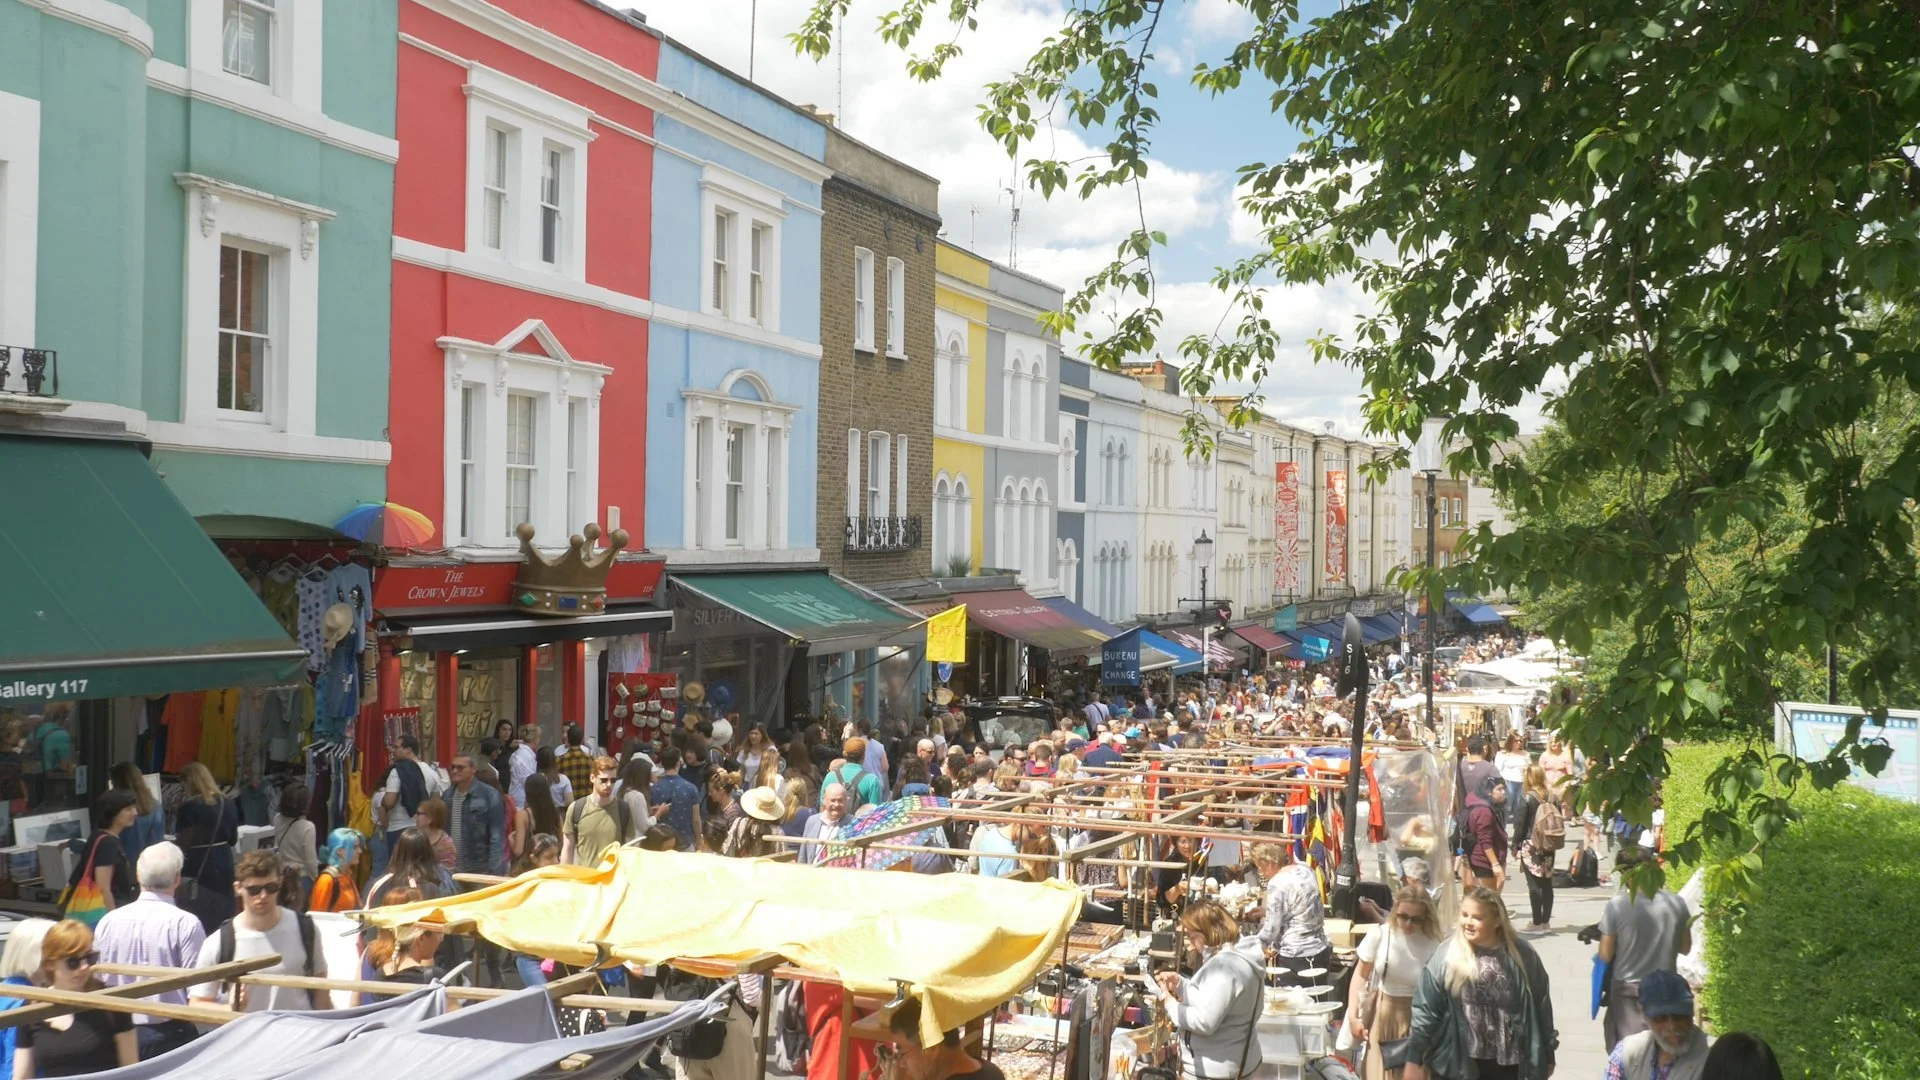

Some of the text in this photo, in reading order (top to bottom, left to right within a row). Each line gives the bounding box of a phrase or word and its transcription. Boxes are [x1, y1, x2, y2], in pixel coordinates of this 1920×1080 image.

[444, 570, 464, 583] THE
[408, 585, 485, 602] CROWN JEWELS
[1104, 650, 1137, 661] BUREAU
[1104, 670, 1136, 680] CHANGE
[0, 679, 88, 699] allery 117
[1794, 712, 1870, 726] PORTOBEO
